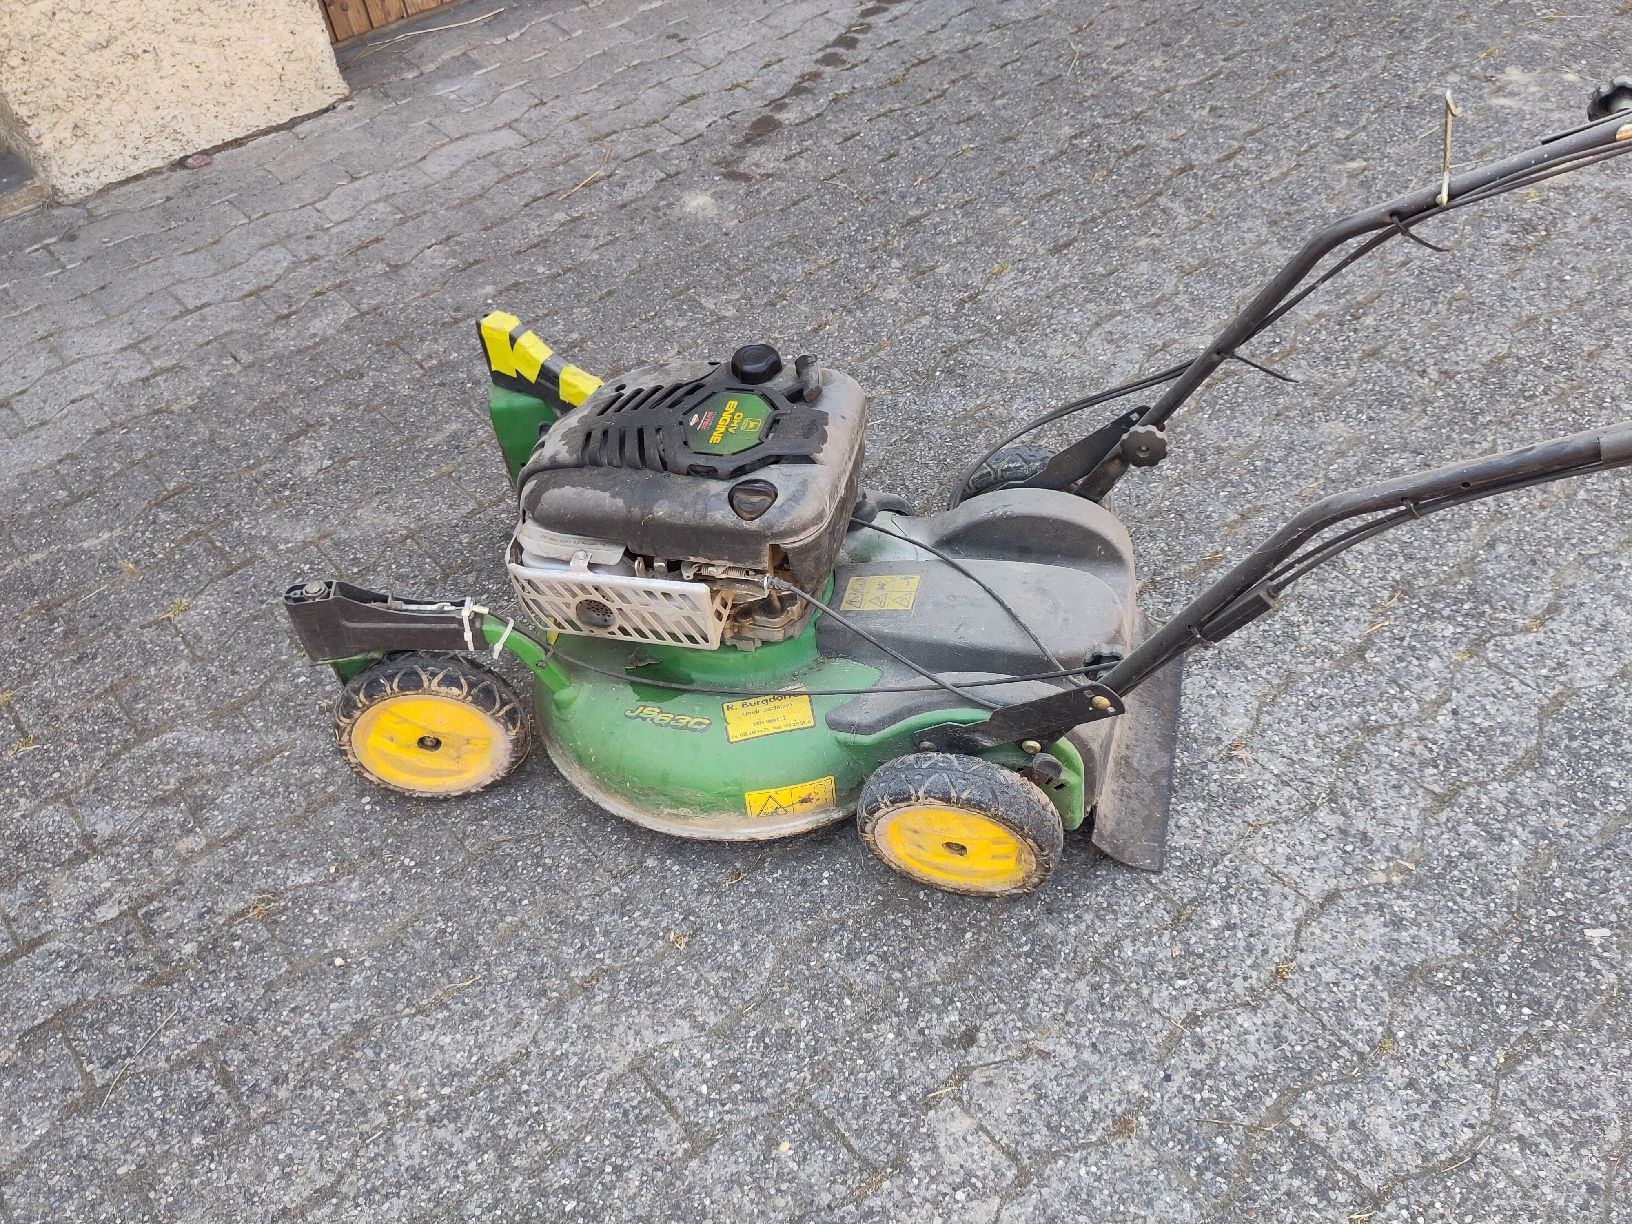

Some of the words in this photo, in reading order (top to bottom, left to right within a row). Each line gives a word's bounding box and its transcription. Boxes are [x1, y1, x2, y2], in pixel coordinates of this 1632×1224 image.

[709, 400, 739, 445] ENGINE
[728, 412, 744, 434] OHV
[741, 693, 805, 709] Burgdor
